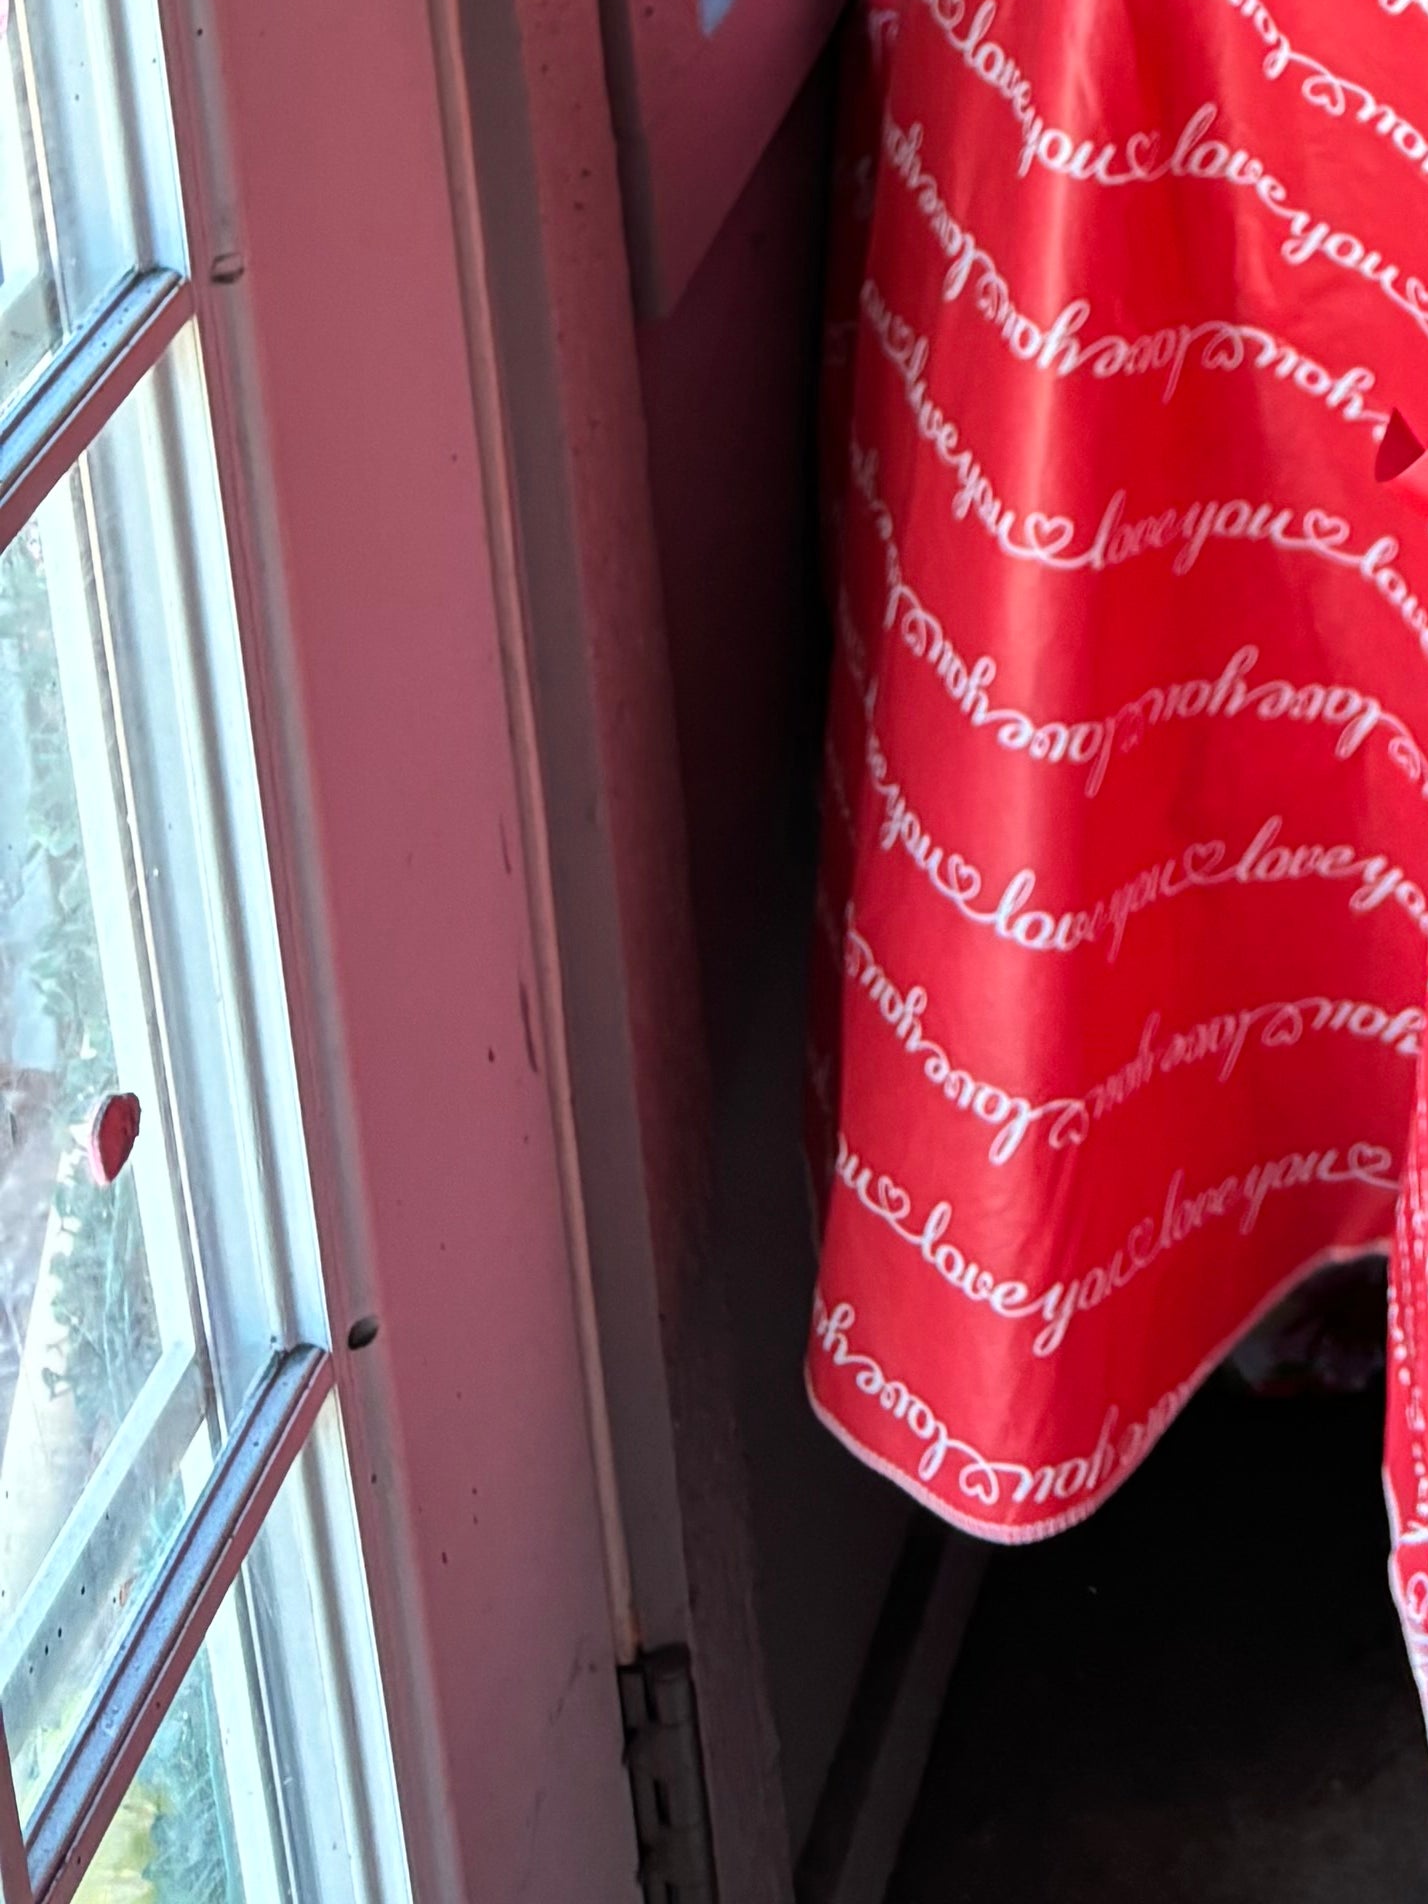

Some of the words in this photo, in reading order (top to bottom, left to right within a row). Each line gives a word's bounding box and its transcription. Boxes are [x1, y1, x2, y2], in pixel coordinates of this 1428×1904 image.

[1018, 106, 1116, 180] you
[1171, 103, 1287, 204] love
[1281, 212, 1400, 284] you
[1255, 331, 1376, 422] you
[998, 710, 1117, 799] love
[1256, 680, 1382, 761] love
[1236, 814, 1356, 884] love
[924, 1040, 1030, 1166] love
[921, 1200, 1030, 1318] love
[856, 1355, 949, 1482] love
